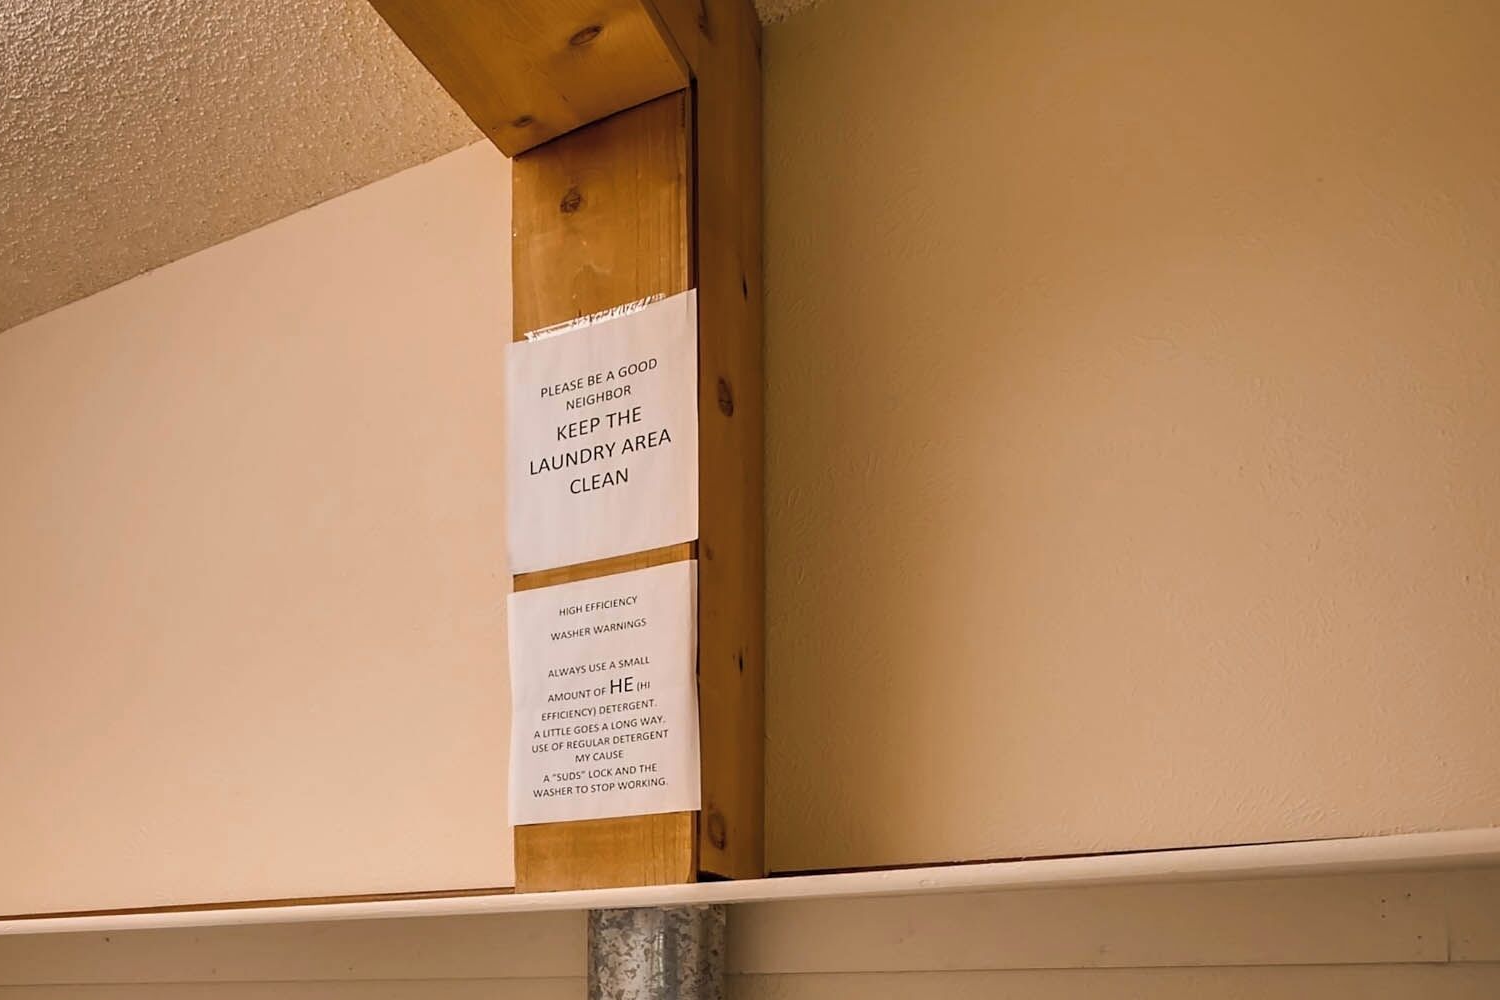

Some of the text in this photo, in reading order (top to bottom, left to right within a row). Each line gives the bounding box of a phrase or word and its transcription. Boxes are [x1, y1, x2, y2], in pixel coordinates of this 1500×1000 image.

[541, 358, 657, 398] PLEASE BE A GOOD
[566, 385, 631, 410] NEIGHBOR
[557, 406, 642, 441] KEEP THE
[530, 429, 671, 475] LAUNDRY AREA
[570, 468, 629, 494] CLEAN
[560, 595, 637, 616] HIGH EFFICIENCY
[551, 618, 646, 641] WASHER WARNINGS
[548, 665, 586, 678] ALWAYS
[589, 662, 606, 673] USE
[619, 656, 650, 668] SMALL
[548, 677, 650, 703] AMOUNT OF HE (HI
[541, 707, 596, 722] EFFICIENCY)
[534, 730, 540, 739] A
[543, 727, 571, 738] LITTLE
[574, 724, 599, 735] GOES
[611, 718, 637, 730] LONG
[640, 715, 665, 726] WAY.
[532, 729, 669, 754] USE OF REGULAR DETERGENT
[575, 750, 624, 763] MY CAUSE
[543, 774, 550, 783] A
[589, 766, 612, 779] LOCK
[615, 765, 636, 776] AND
[640, 763, 657, 773] THE
[533, 778, 668, 798] WASHER TO STOP WORKING.
